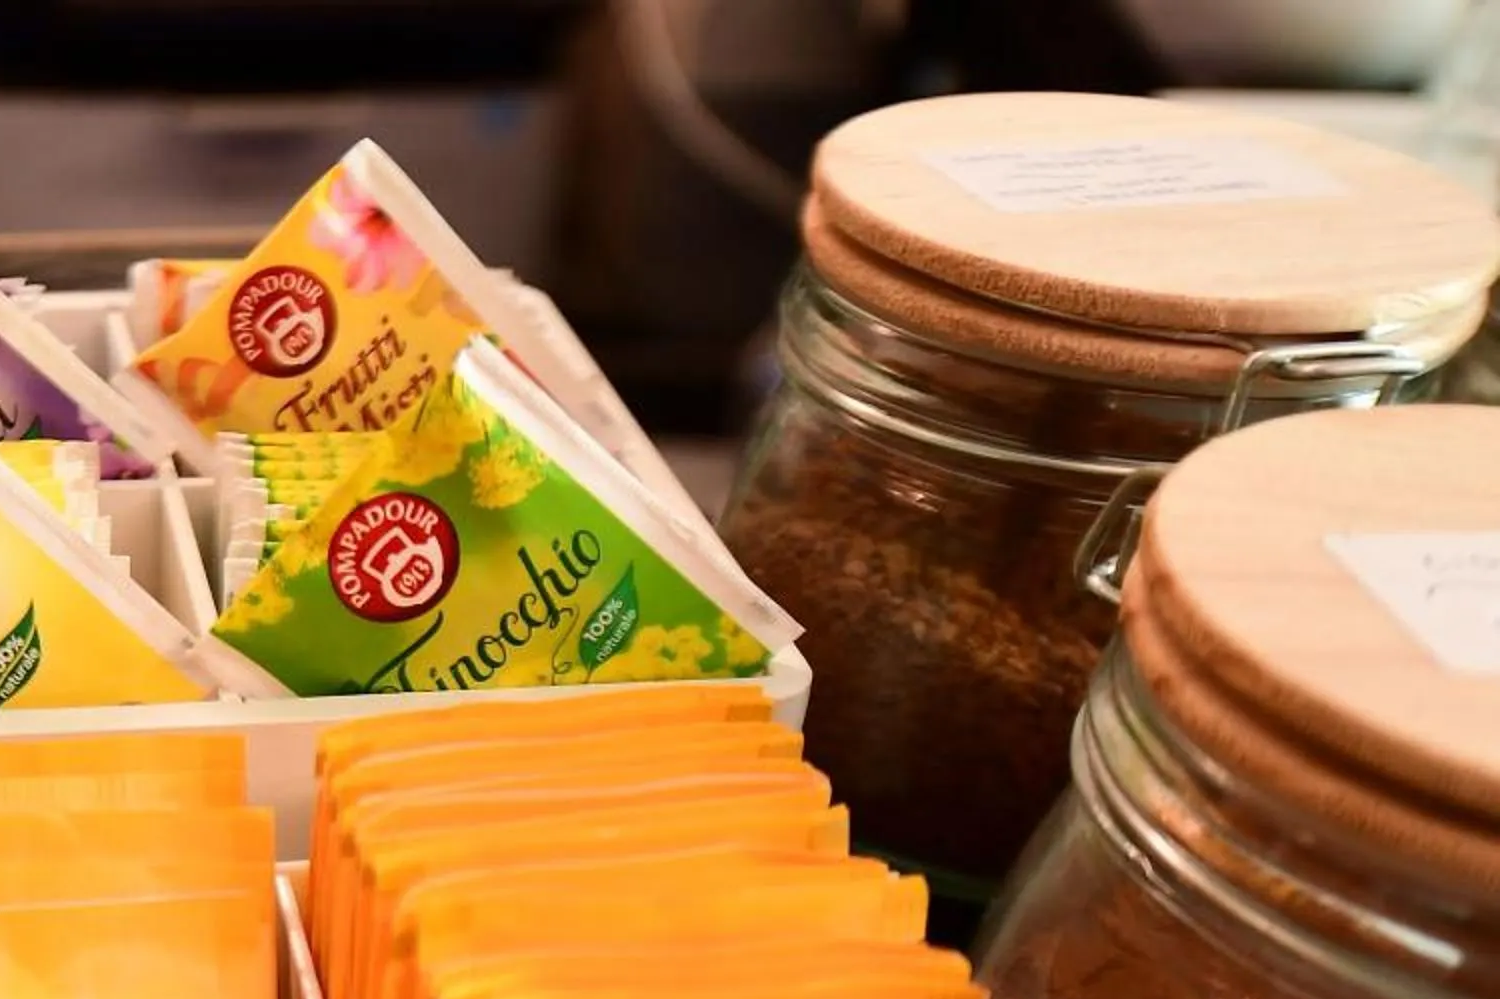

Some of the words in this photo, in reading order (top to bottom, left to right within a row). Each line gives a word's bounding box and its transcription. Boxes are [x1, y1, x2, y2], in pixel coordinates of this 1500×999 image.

[233, 271, 325, 362] POMPADOUR
[273, 314, 407, 433] Frutti
[337, 499, 439, 609] POMPADOUR
[396, 559, 432, 596] 1913
[582, 597, 624, 642] 100%
[0, 647, 40, 699] naturale
